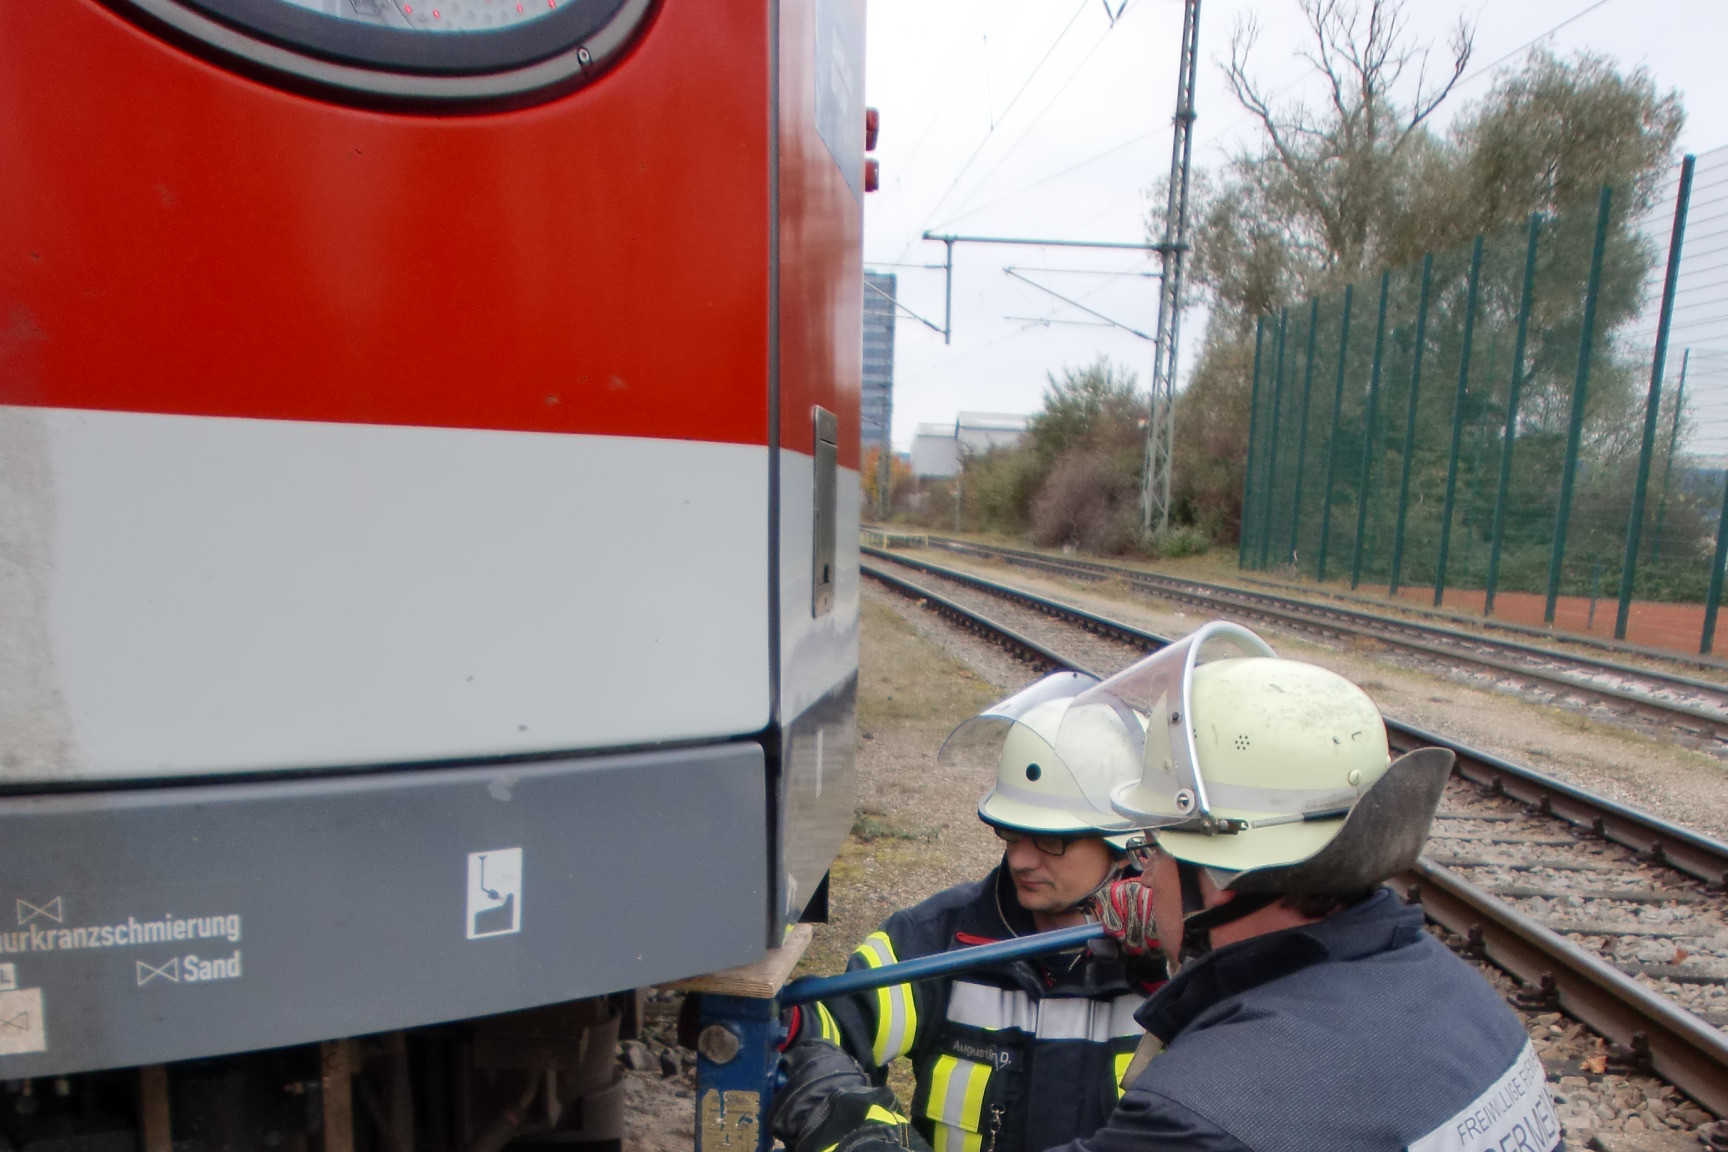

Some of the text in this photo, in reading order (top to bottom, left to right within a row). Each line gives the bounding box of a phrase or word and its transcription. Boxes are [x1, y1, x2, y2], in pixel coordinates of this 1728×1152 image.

[0, 913, 242, 953] urkranzschmierung
[183, 950, 242, 983] Sand
[953, 1040, 998, 1071] Augustin
